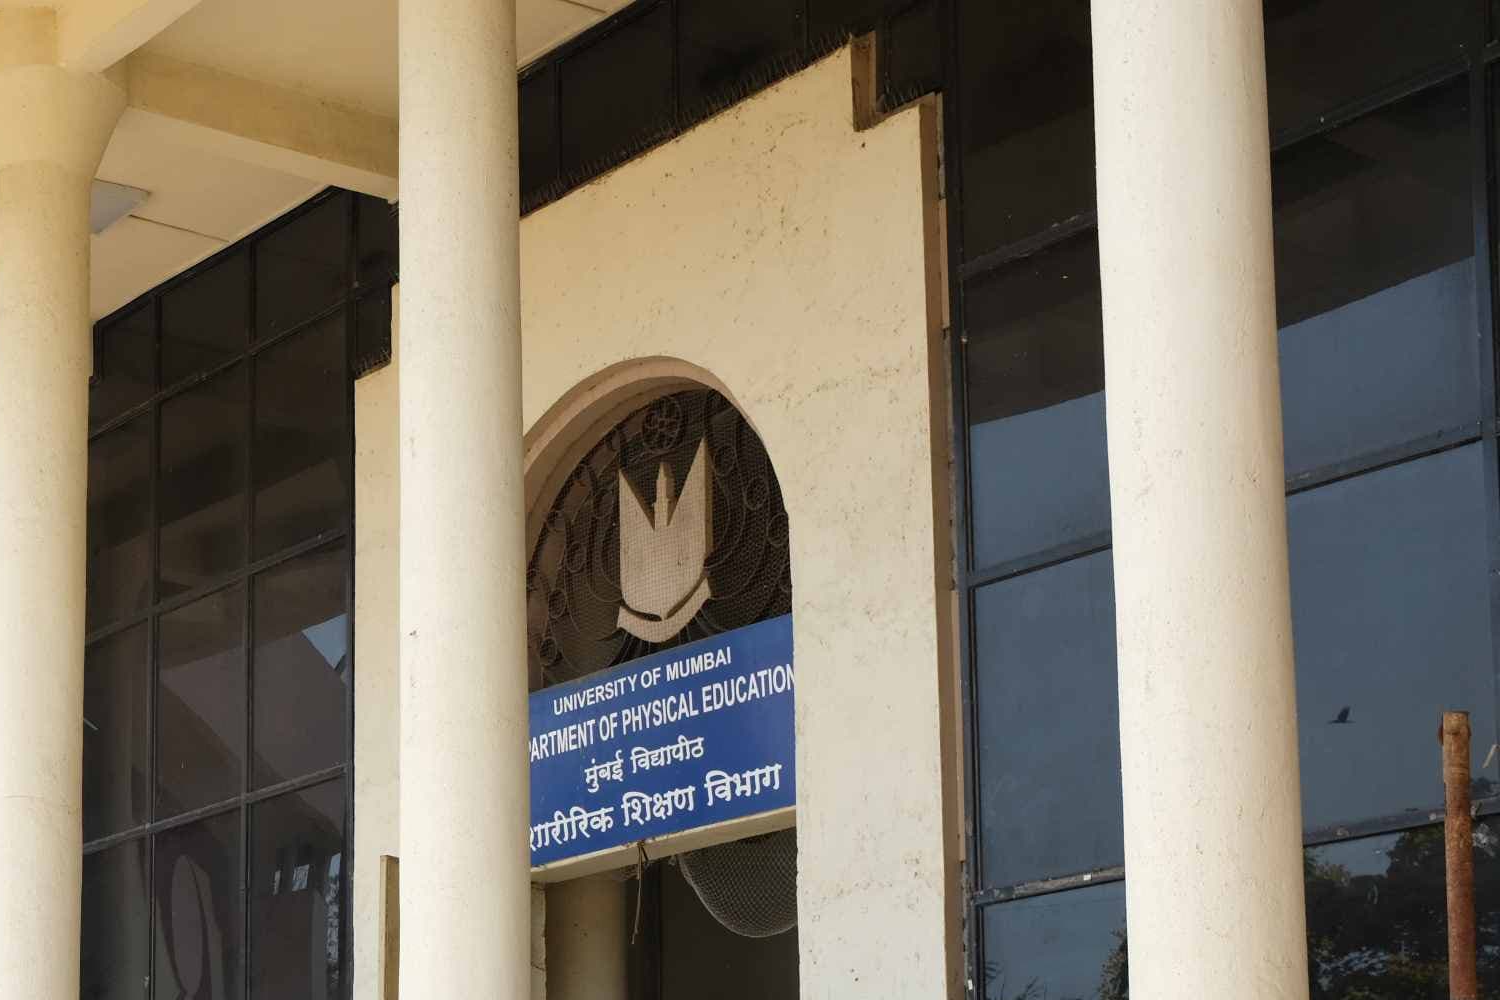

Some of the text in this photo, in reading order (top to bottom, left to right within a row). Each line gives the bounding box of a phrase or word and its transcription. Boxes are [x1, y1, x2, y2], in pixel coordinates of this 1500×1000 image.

[529, 663, 795, 762] ARTMENT OF PHYSICAL EDUCATION
[553, 646, 731, 715] UNIVERSITY OF MUMBAI
[584, 735, 704, 793] मुंबई विद्यापीठ
[621, 784, 696, 826] शिक्षण
[704, 763, 782, 806] विभाग
